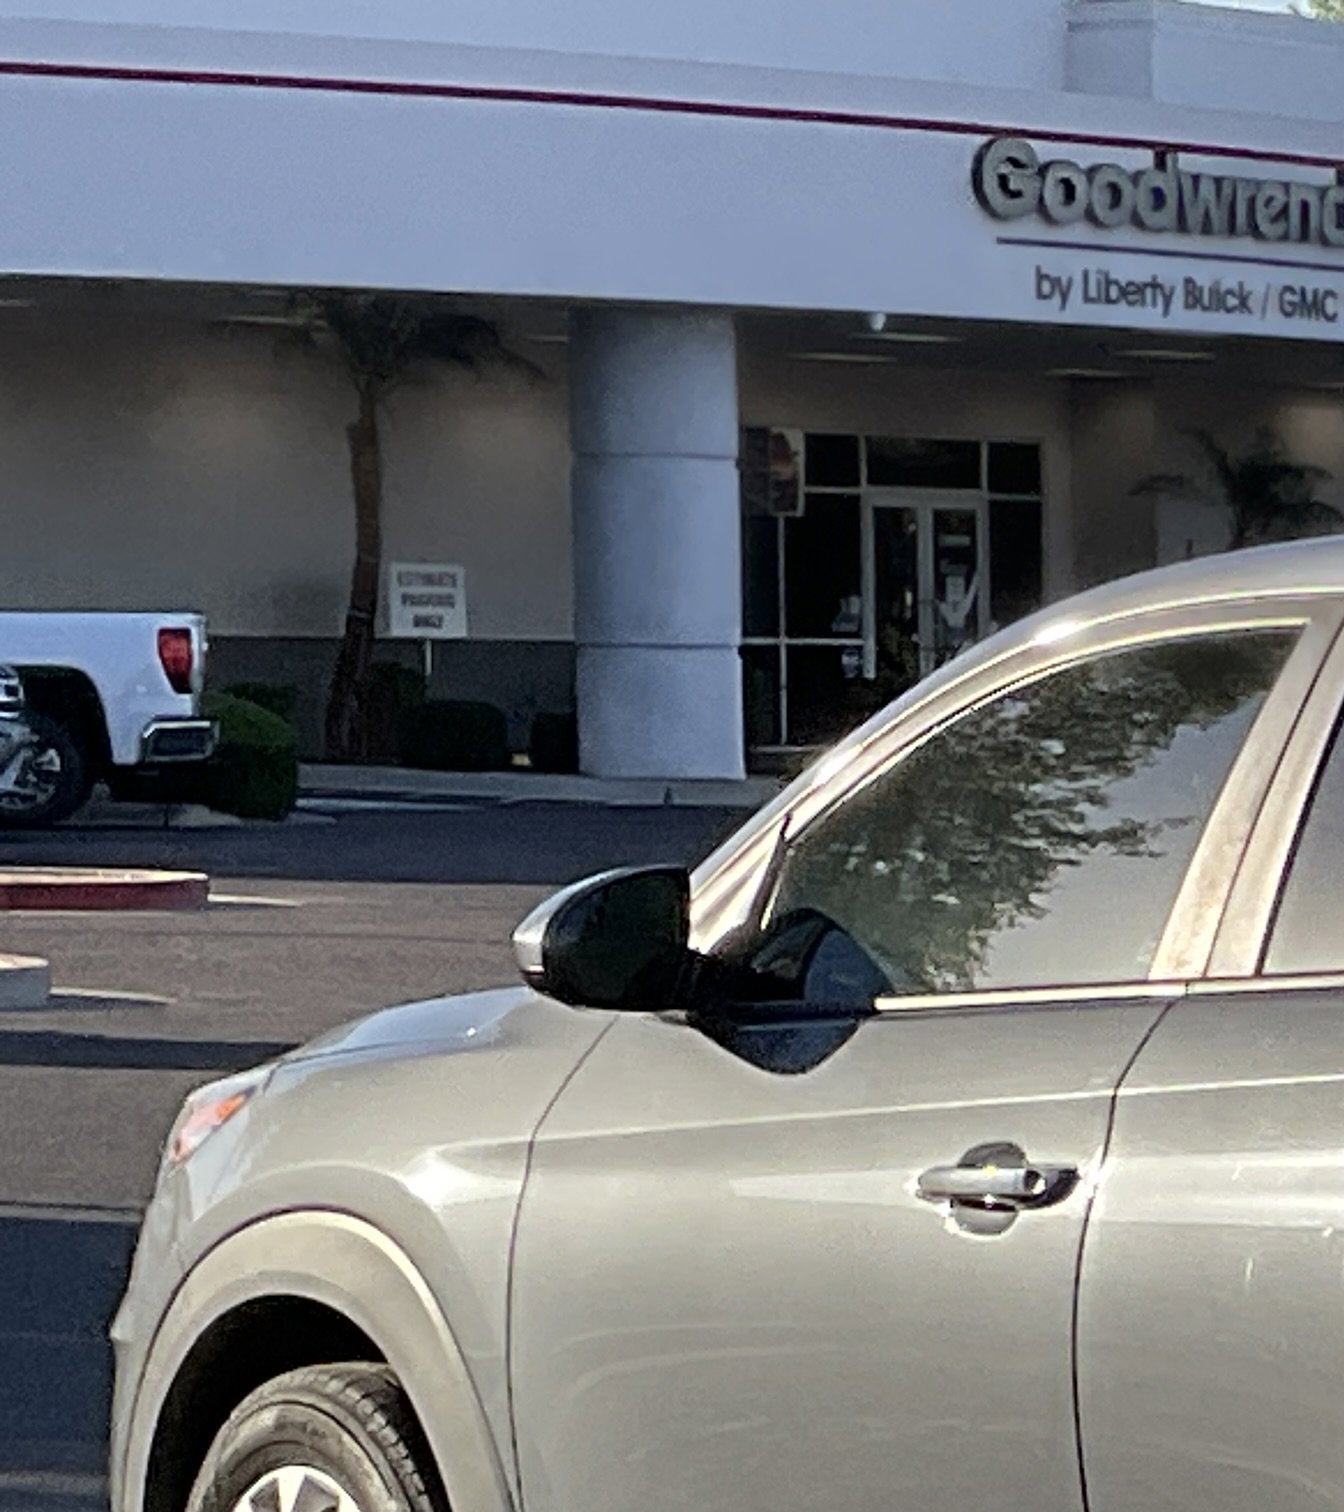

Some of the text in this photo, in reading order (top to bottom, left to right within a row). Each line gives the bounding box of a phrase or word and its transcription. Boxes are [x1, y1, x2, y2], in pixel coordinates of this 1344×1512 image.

[1034, 264, 1073, 312] by
[1082, 267, 1176, 318] Liberty
[1183, 276, 1253, 315] Buick
[1279, 288, 1339, 322] GMC
